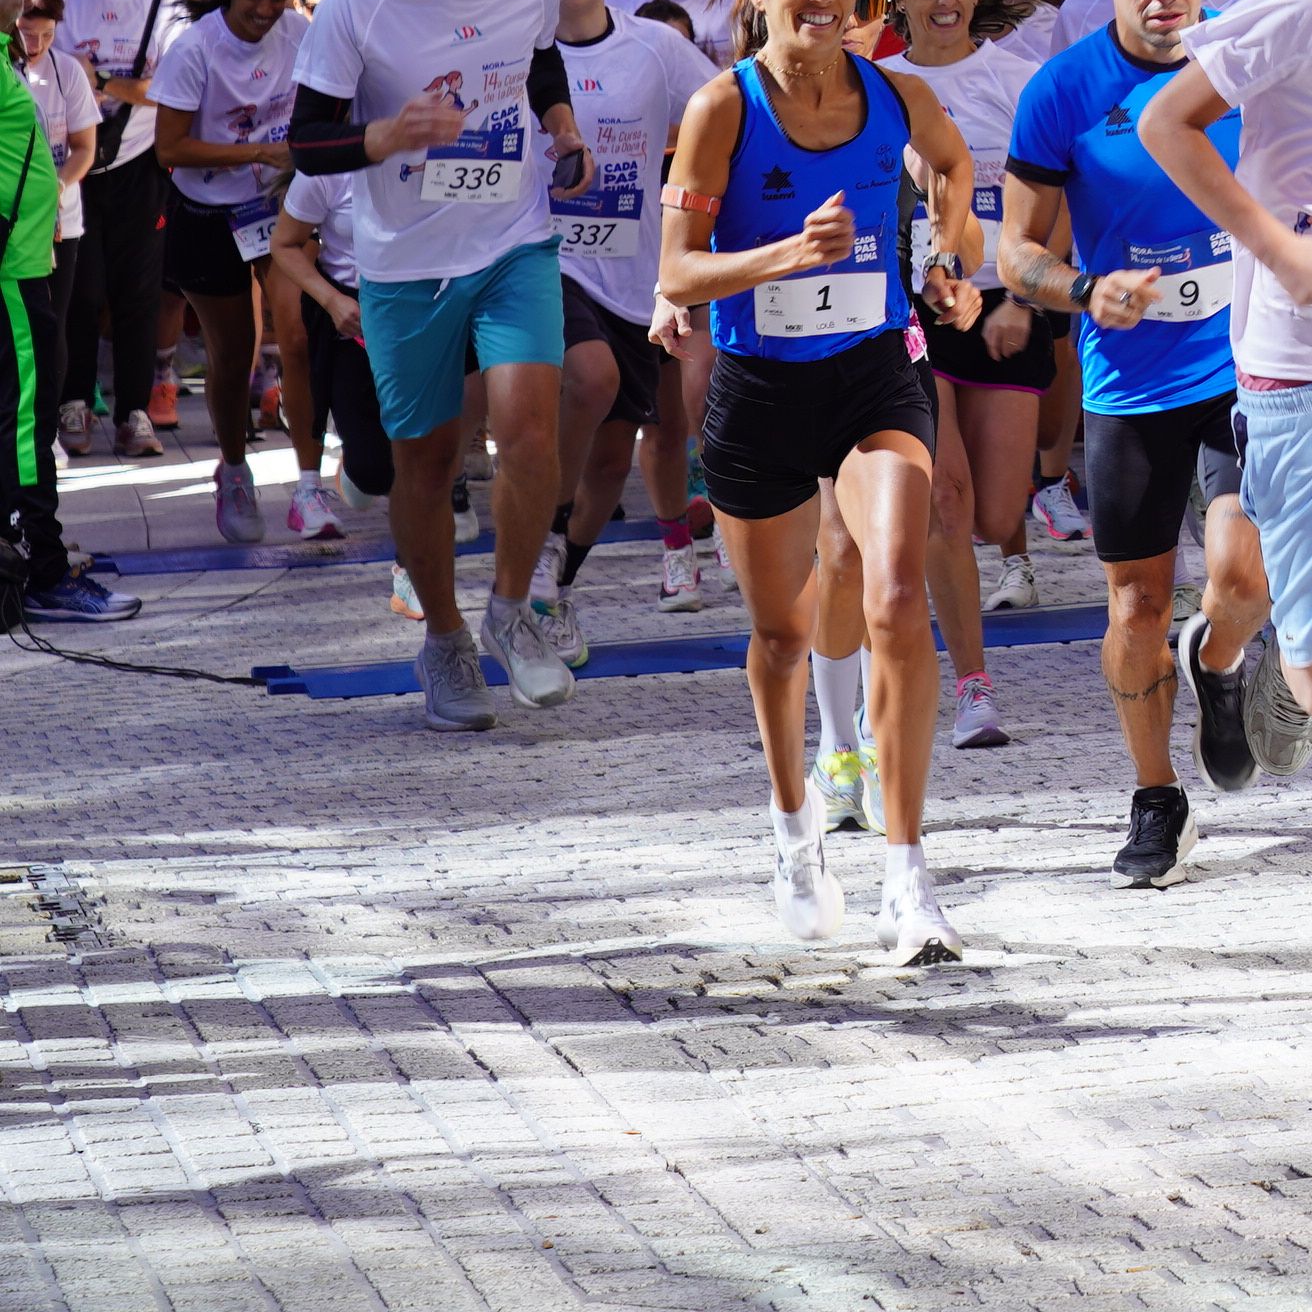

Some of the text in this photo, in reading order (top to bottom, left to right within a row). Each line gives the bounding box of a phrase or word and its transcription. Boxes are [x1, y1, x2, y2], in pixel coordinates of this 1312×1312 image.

[490, 103, 519, 122] CADA
[603, 160, 638, 173] CADA
[448, 162, 503, 191] 336
[603, 170, 638, 184] PAS
[565, 222, 618, 246] 337
[853, 243, 878, 255] PAS
[854, 252, 878, 264] SUMA
[815, 284, 833, 313] 1
[1179, 279, 1200, 307] 9
